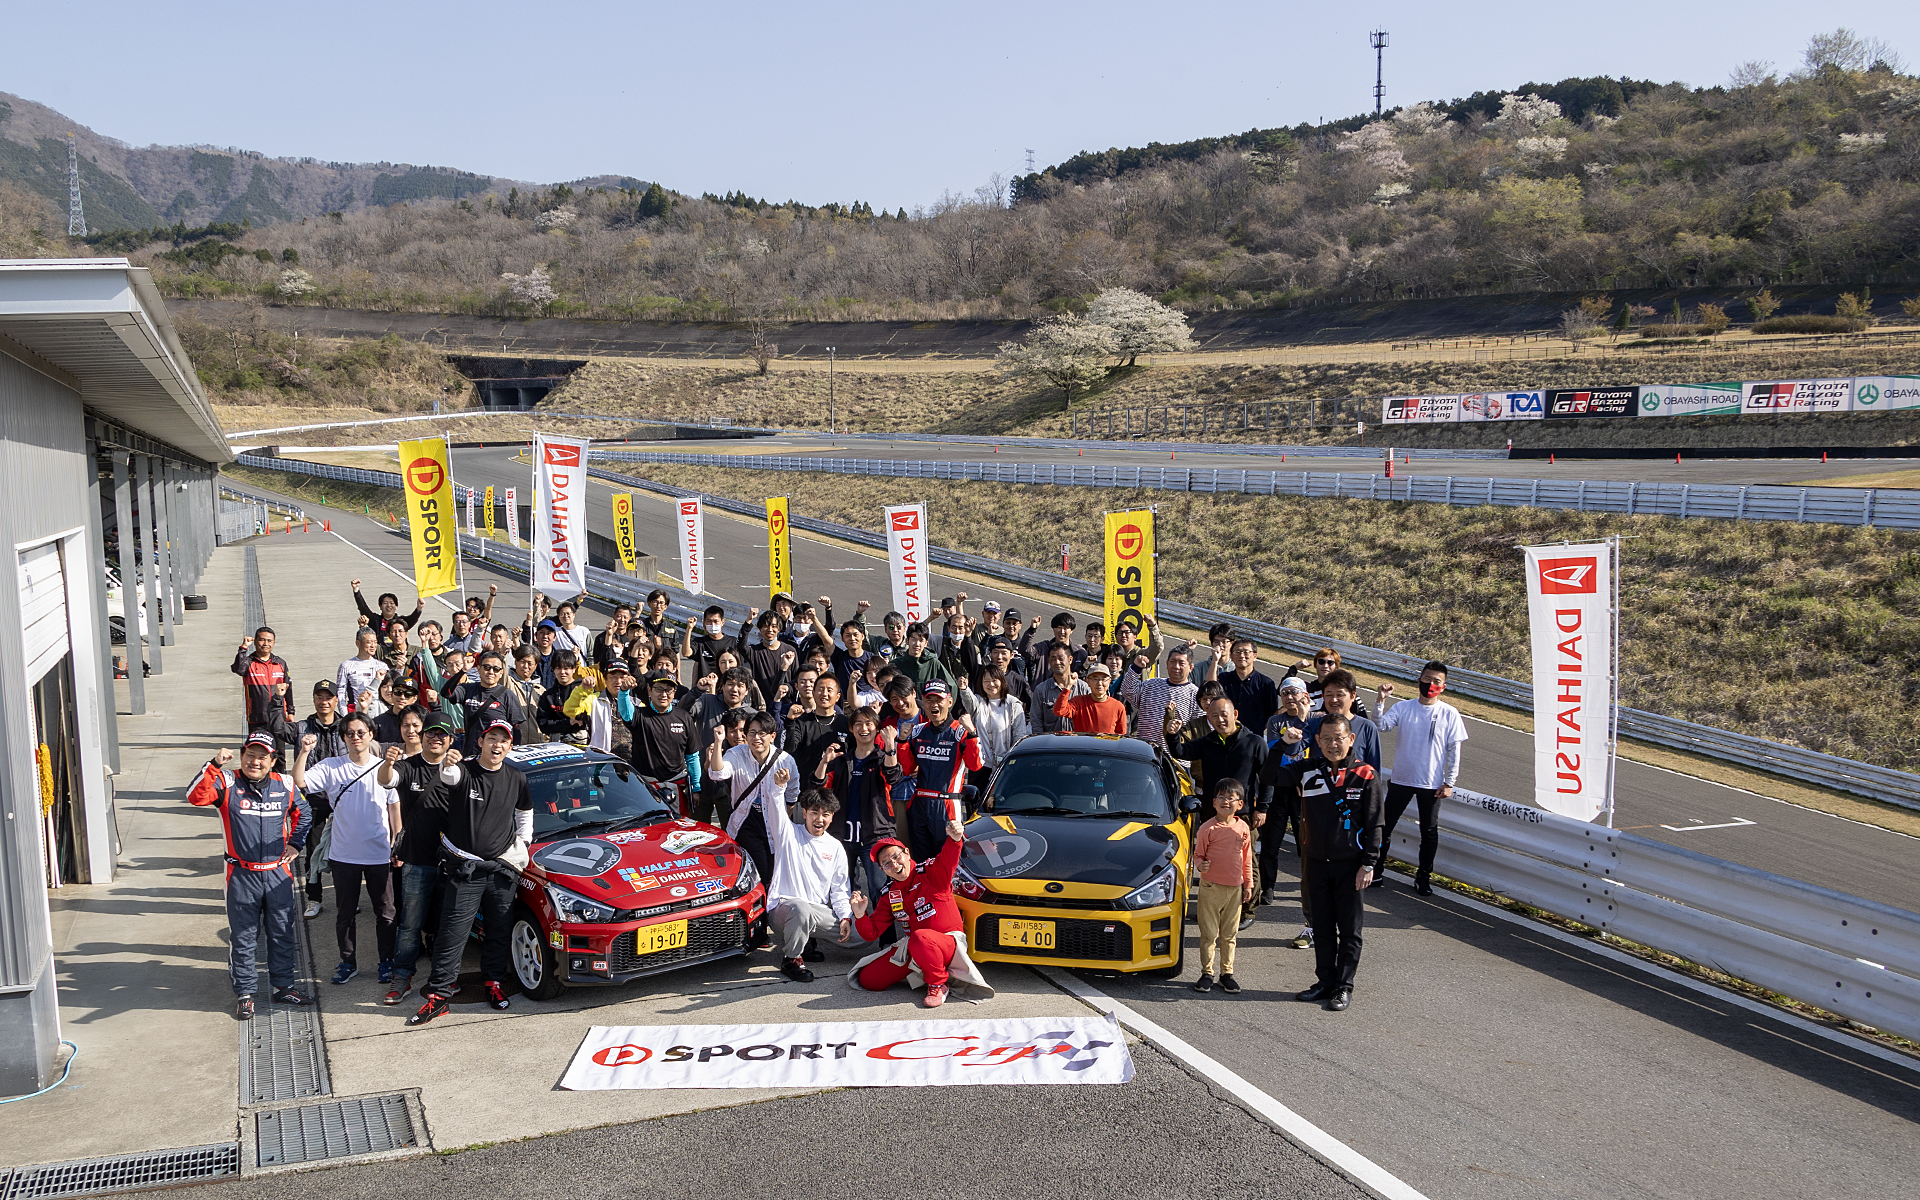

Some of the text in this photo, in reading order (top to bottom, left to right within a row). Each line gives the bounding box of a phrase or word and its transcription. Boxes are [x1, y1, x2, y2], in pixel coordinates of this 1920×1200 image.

[1799, 383, 1849, 391] TOYOTA
[1592, 391, 1633, 399] TOYOTA
[1795, 391, 1843, 399] GAZOO
[1883, 389, 1920, 398] OBAYA
[1554, 400, 1587, 412] GR
[1590, 398, 1628, 406] GAZOO
[1664, 394, 1740, 406] OBAYASHI ROAD
[1748, 393, 1792, 408] GR
[1793, 399, 1840, 408] Racing
[1387, 407, 1417, 419] GR
[1589, 404, 1625, 413] Racing
[1418, 411, 1451, 419] Racing
[420, 498, 442, 570] SPORT
[551, 473, 570, 584] DAIHATSU
[619, 517, 635, 565] SPORT
[774, 538, 783, 589] SPORT
[926, 746, 951, 756] SPORT
[252, 801, 282, 811] SPORT
[596, 852, 619, 873] D-SPORT
[639, 856, 700, 875] HALF WAY
[995, 860, 1033, 876] D-SPORT
[659, 868, 709, 884] DAIHATSU
[695, 878, 728, 893] SPK
[1012, 921, 1043, 931] 品川 583
[650, 930, 684, 950] 19-07
[660, 1041, 857, 1063] SPORT
[865, 1035, 1073, 1066] Cup
